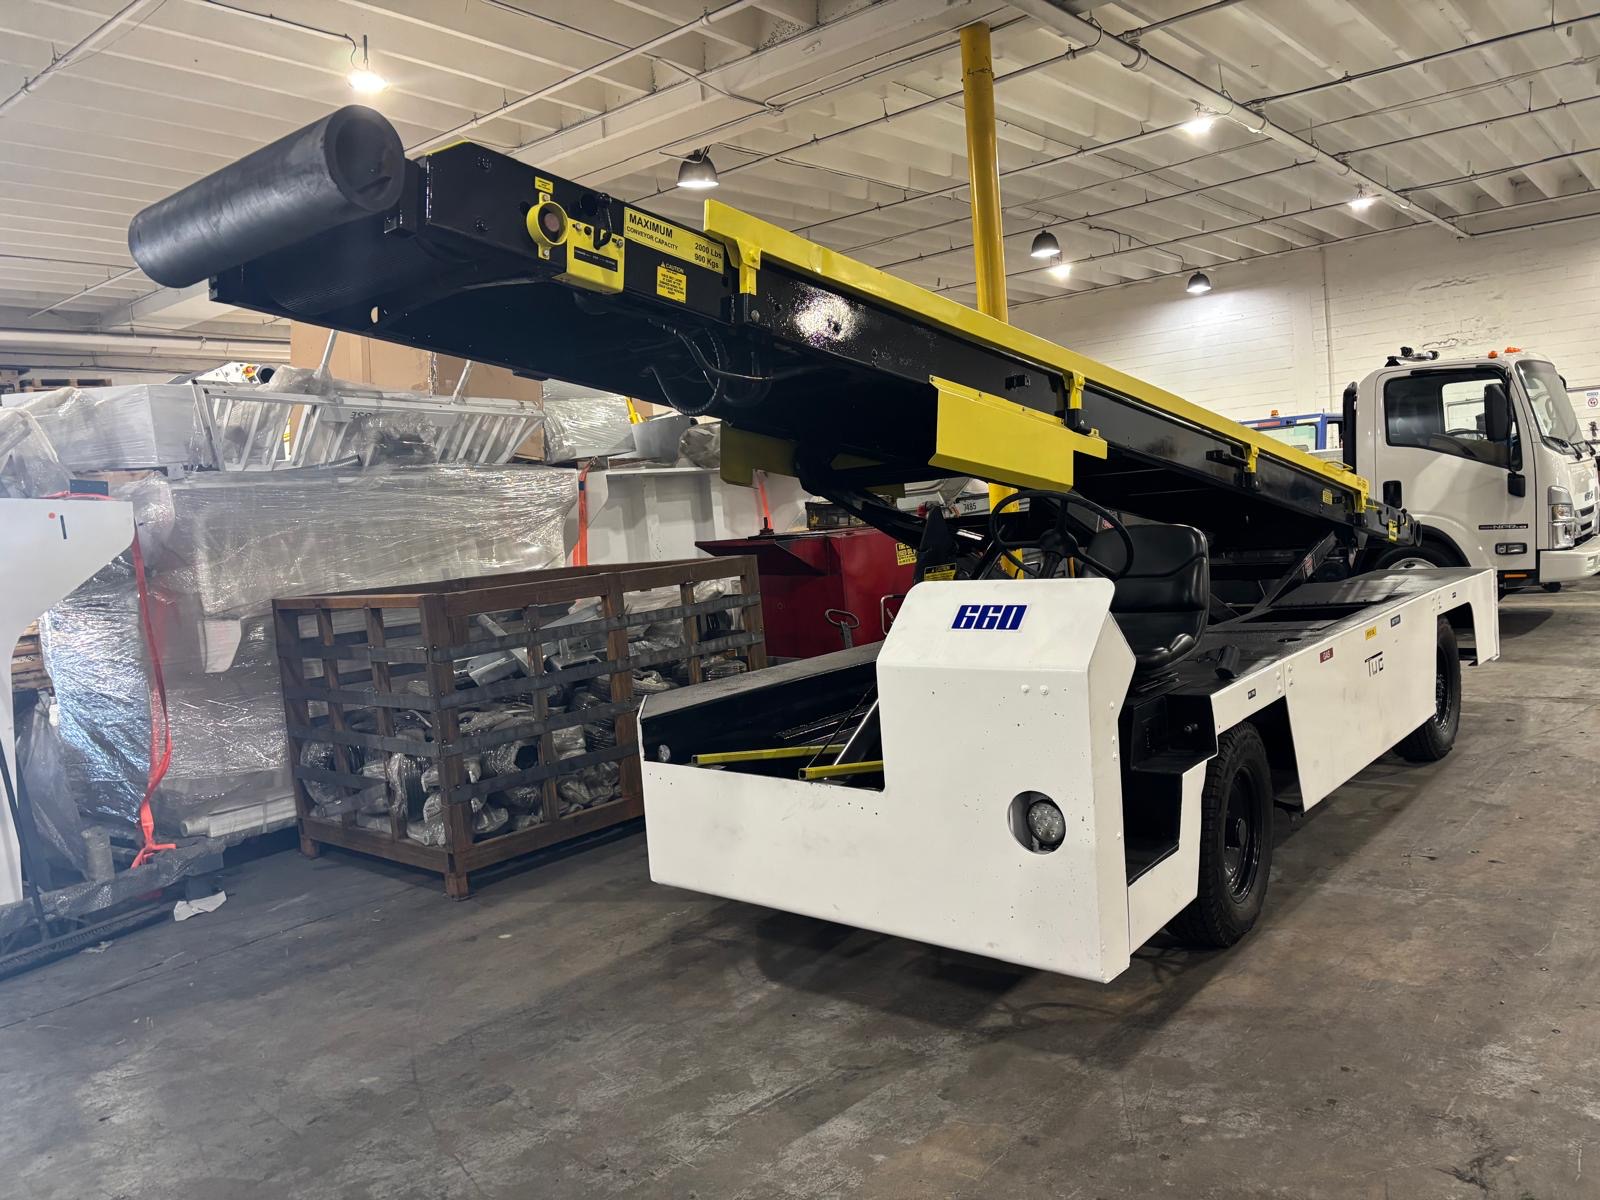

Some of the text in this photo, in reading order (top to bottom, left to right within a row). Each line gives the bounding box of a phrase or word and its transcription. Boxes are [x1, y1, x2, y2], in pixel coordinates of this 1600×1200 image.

[629, 213, 673, 238] MAXIMUM
[626, 225, 679, 251] CONVEYOR CAPACITY
[694, 242, 722, 260] 2000 Lbs
[694, 253, 719, 270] 900 Kgs
[665, 263, 685, 274] CAUTION
[963, 503, 977, 512] 7485
[951, 604, 1028, 630] 660
[1364, 650, 1384, 678] TUG
